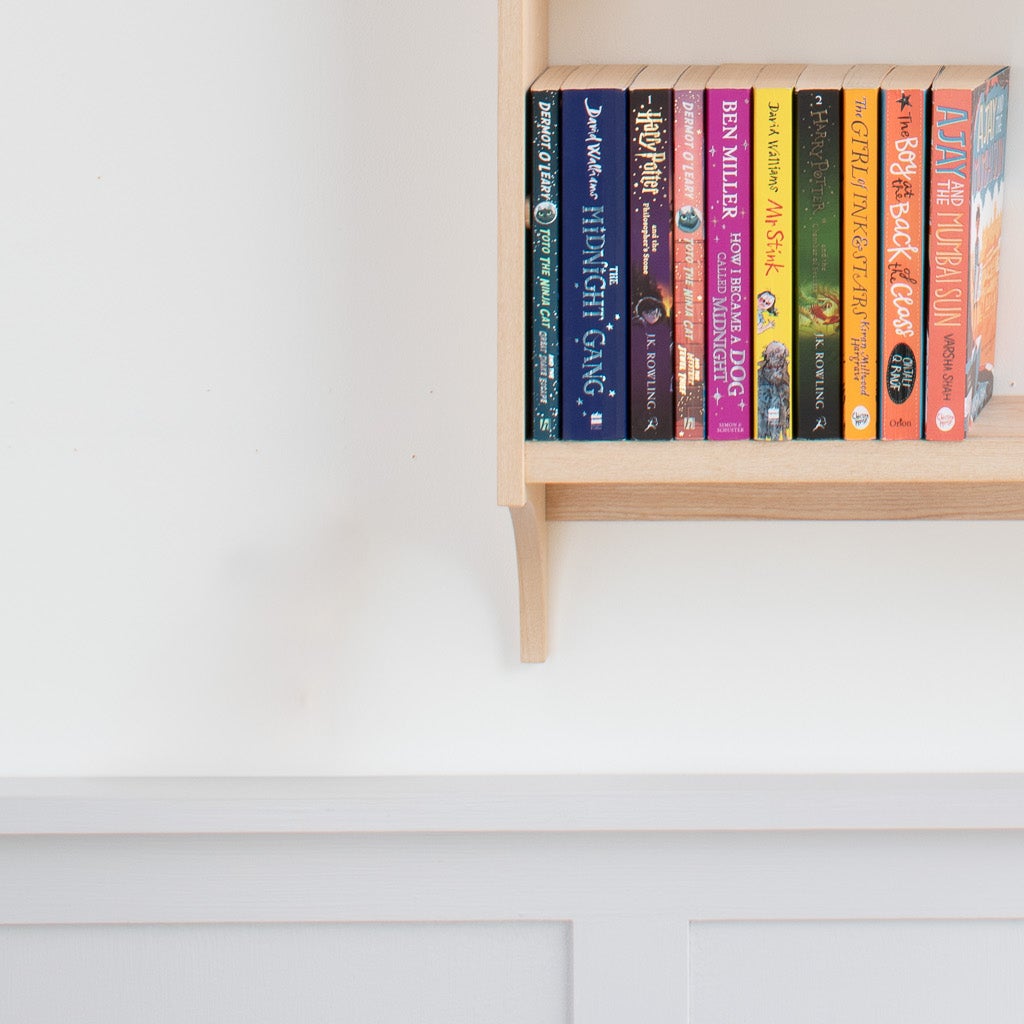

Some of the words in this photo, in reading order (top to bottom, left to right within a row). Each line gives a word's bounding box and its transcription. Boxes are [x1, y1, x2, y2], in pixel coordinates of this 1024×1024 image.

[767, 101, 780, 136] David
[815, 95, 823, 105] 2
[854, 97, 868, 118] The
[538, 101, 552, 149] DERMOT
[585, 97, 603, 142] David
[635, 109, 663, 151] Harry
[682, 101, 694, 148] DERMOT
[722, 100, 738, 140] BEN
[810, 109, 829, 160] HARRY
[897, 111, 912, 138] The
[850, 120, 869, 178] GIRL
[935, 105, 968, 179] AJAY
[538, 151, 552, 201] O'LEARY
[586, 143, 603, 200] Walliams
[634, 152, 666, 196] Potter
[682, 151, 694, 200] O'LEARY
[722, 145, 738, 220] MILLER
[767, 140, 780, 193] Walliams
[850, 178, 868, 190] of
[810, 159, 829, 215] POTTER
[891, 178, 903, 202] the
[902, 181, 914, 199] at
[936, 179, 951, 205] THE
[950, 180, 965, 207] AND
[641, 203, 650, 252] Philosopher's
[651, 225, 659, 239] and
[765, 199, 783, 227] Mr
[851, 192, 868, 237] INK
[539, 229, 551, 255] TOTO
[651, 240, 659, 252] the
[684, 237, 694, 264] TOTO
[730, 232, 741, 266] HOW
[765, 230, 785, 276] Stink
[934, 212, 964, 283] MUMBAI
[540, 257, 551, 276] THE
[609, 265, 619, 286] THE
[642, 254, 650, 275] Stone
[683, 267, 694, 286] THE
[717, 252, 727, 294] CALLED
[888, 262, 902, 284] the
[898, 267, 917, 285] of
[540, 278, 551, 306] NINJA
[683, 288, 694, 317] NINJA
[730, 277, 742, 332] BECAME
[851, 251, 868, 320] STARS
[539, 308, 551, 329] CAT
[890, 282, 915, 337] Class
[932, 288, 962, 326] SUN
[683, 319, 694, 340] CAT
[712, 296, 728, 383] MIDNIGHT
[731, 335, 741, 345] A
[861, 320, 870, 349] Kiran
[582, 329, 606, 397] GANG
[849, 337, 860, 381] Hargrave
[942, 333, 955, 371] VARSHA
[646, 353, 656, 410] ROWLING
[728, 348, 746, 397] DOG
[815, 352, 825, 410] ROWLING
[860, 352, 870, 397] Millwood
[942, 374, 954, 401] SHAH
[889, 418, 912, 427] Orion
